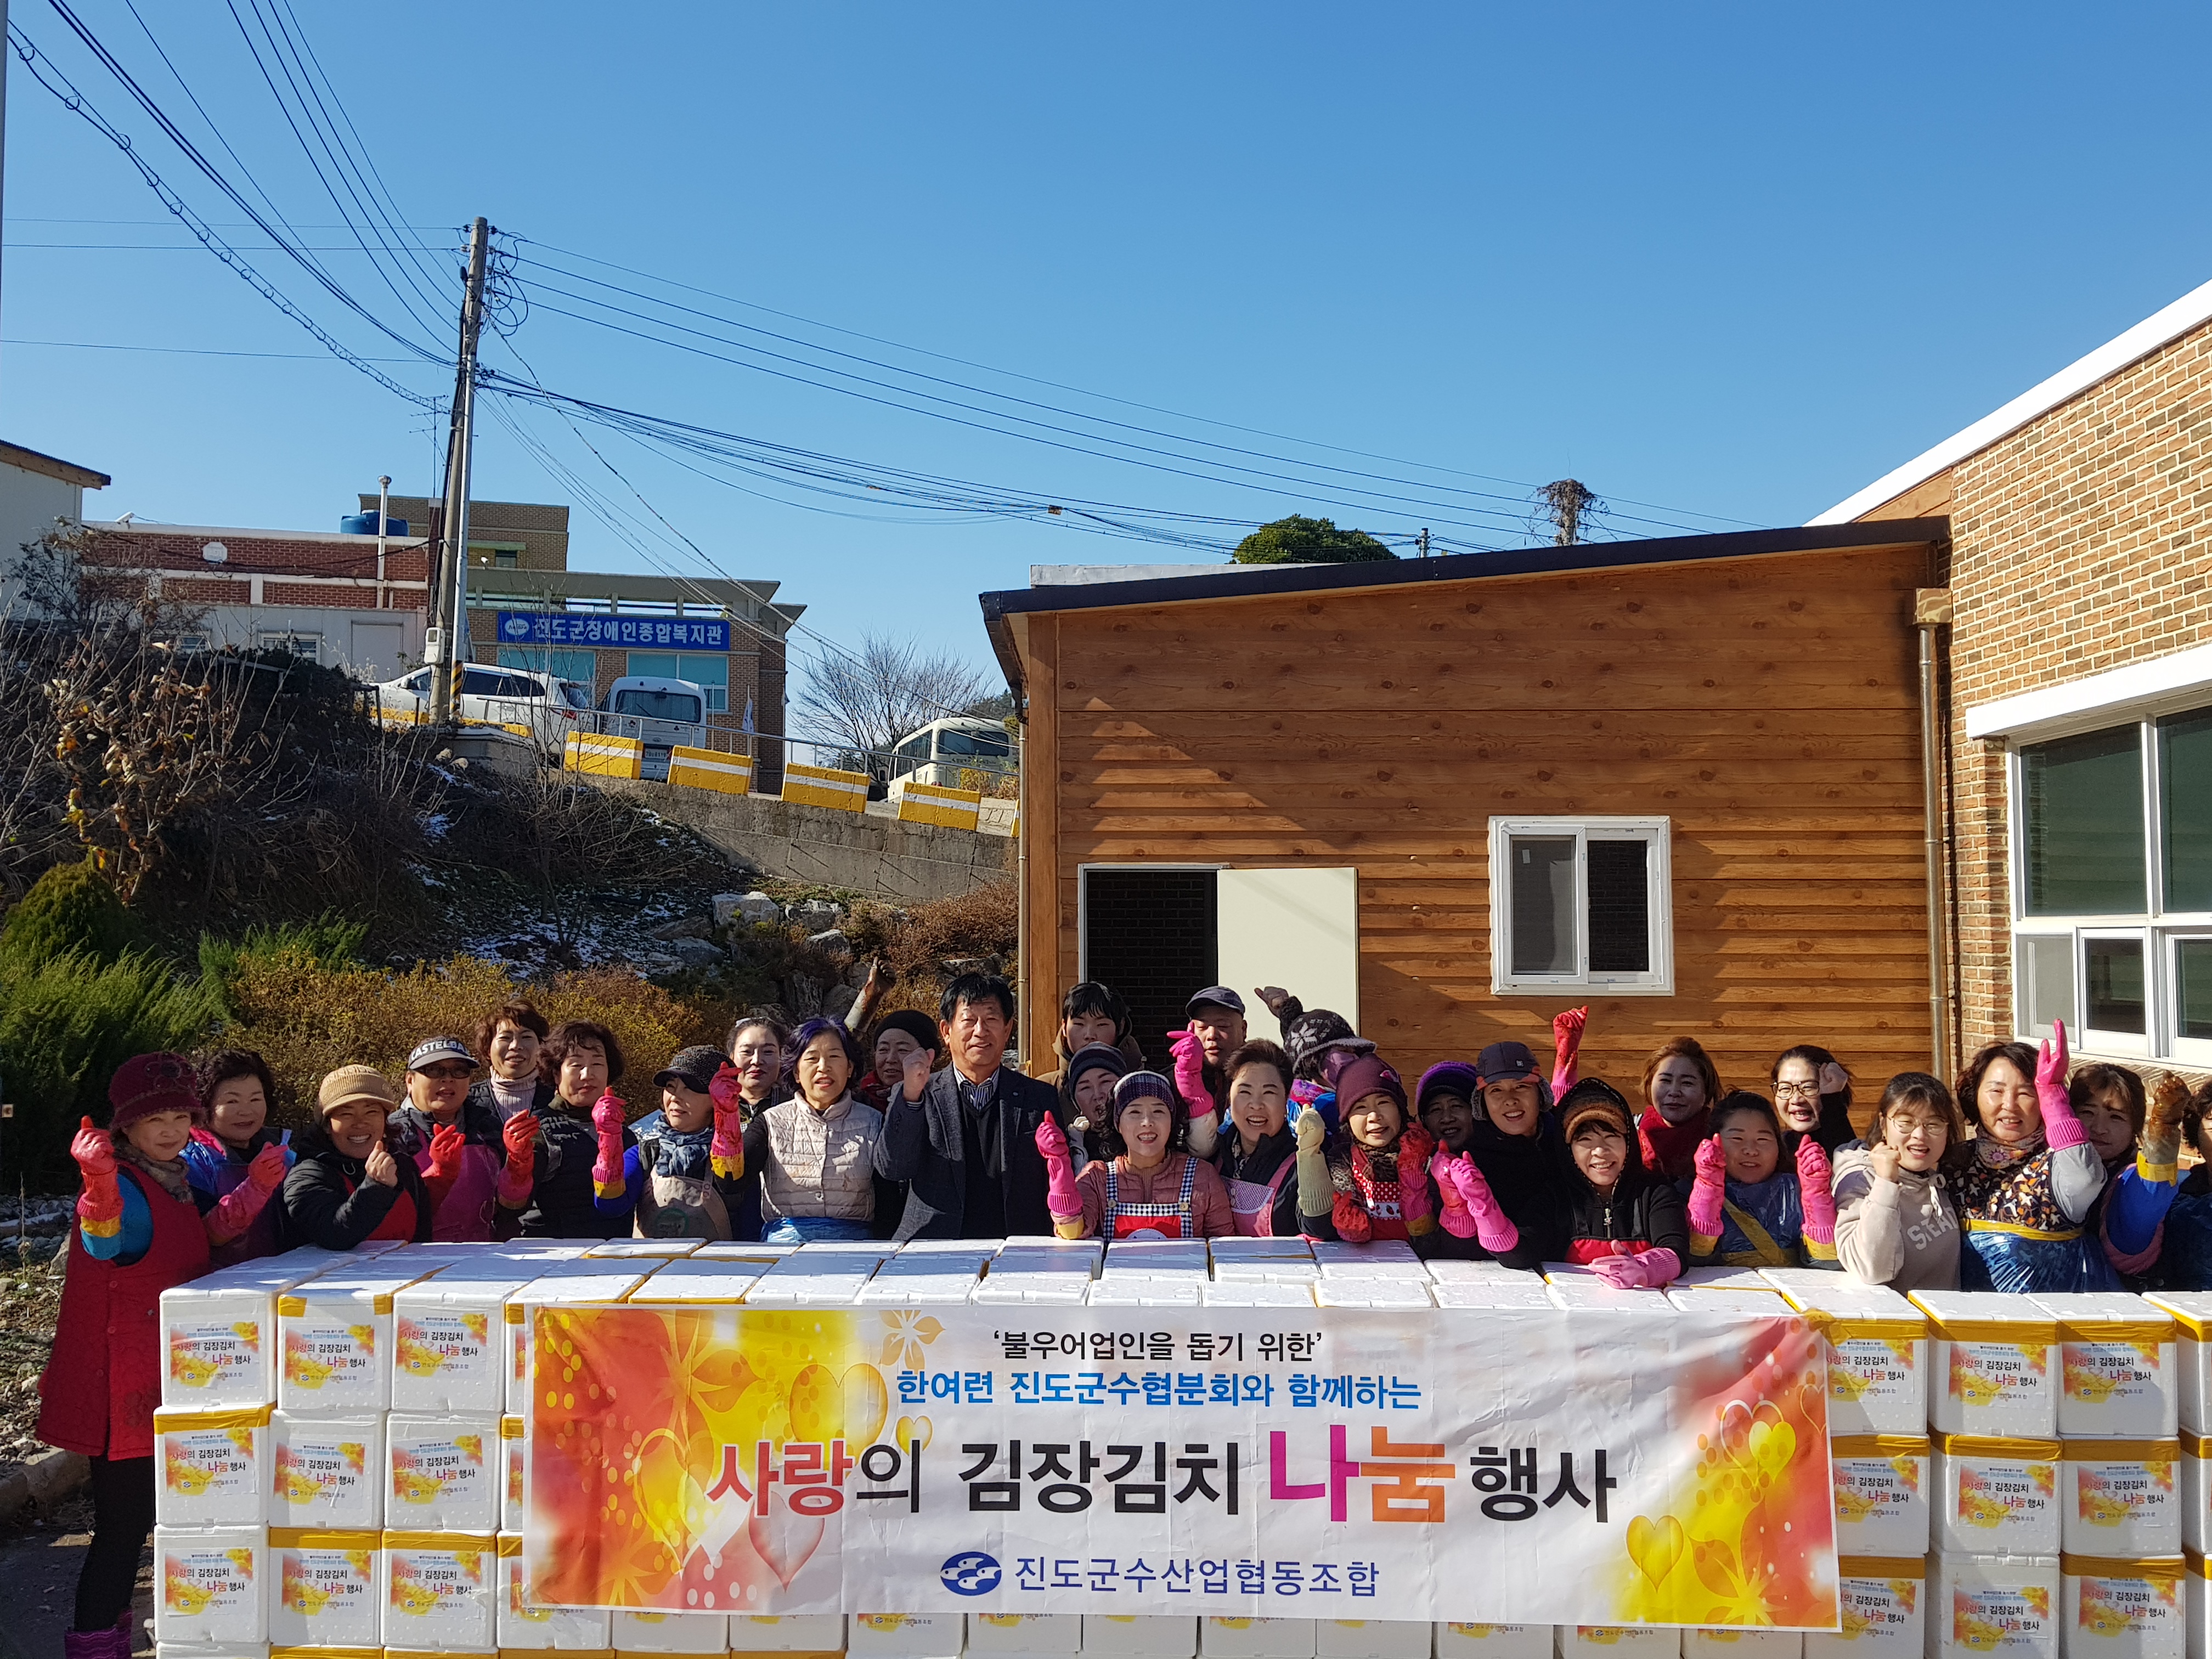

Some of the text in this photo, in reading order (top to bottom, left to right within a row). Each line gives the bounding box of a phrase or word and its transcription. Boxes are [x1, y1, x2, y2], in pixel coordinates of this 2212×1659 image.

[534, 618, 723, 645] 진도군장애인종합복지관
[403, 1331, 463, 1341] 사랑의 김장김치
[176, 1340, 235, 1352] 사랑의 김장김치
[291, 1343, 351, 1353] 사랑의 김장김치
[439, 1344, 478, 1356] 나눔 행사
[1187, 1332, 1244, 1362] 돕기
[212, 1353, 251, 1365] 나눔 행사
[327, 1356, 365, 1368] 나눔 행사
[1854, 1356, 1888, 1365] 김장김치
[1956, 1359, 2021, 1371] 사랑의 김장김치
[2069, 1356, 2134, 1367] 사랑의 김장김치
[1864, 1368, 1905, 1380] 나눔 행사
[2109, 1369, 2152, 1381] 나눔 행사
[1996, 1374, 2036, 1387] 나눔 행사
[896, 1370, 1421, 1409] 한여련 진도군수협분회와 함께하는
[171, 1447, 230, 1460] 사랑의 김장김치
[207, 1460, 246, 1474] 나눔 행사
[281, 1458, 340, 1470] 사랑의 김장김치
[398, 1454, 459, 1470] 사랑의 김장김치
[317, 1472, 354, 1486] 나눔 행사
[436, 1468, 476, 1481] 나눔 행사
[706, 1425, 1617, 1523] 사랑의 김장김치 나눔 행사
[1859, 1477, 1893, 1487] 김장김치
[1966, 1481, 2029, 1493] 사랑의 김장김치
[2085, 1479, 2147, 1491] 사랑의 김장김치
[1868, 1490, 1909, 1503] 나눔 행사
[2004, 1496, 2044, 1509] 나눔 행사
[2123, 1492, 2164, 1505] 나눔 행사
[171, 1567, 229, 1578] 사랑의 김장김치
[288, 1569, 347, 1579] 사랑의 김장김치
[397, 1570, 456, 1580] 사랑의 김장김치
[1015, 1556, 1380, 1597] 진도군수산업협동조합
[207, 1580, 245, 1593] 나눔 행사
[324, 1582, 363, 1594] 나눔 행사
[433, 1583, 454, 1594] 나눔
[1855, 1595, 1889, 1607] 김장김치
[2086, 1590, 2149, 1602] 사랑의 김장김치
[1960, 1605, 2023, 1615] 사랑의 김장김치
[2125, 1605, 2166, 1617] 나눔 행사
[1864, 1609, 1904, 1624] 나눔 행사
[1999, 1618, 2040, 1630] 나눔 행사
